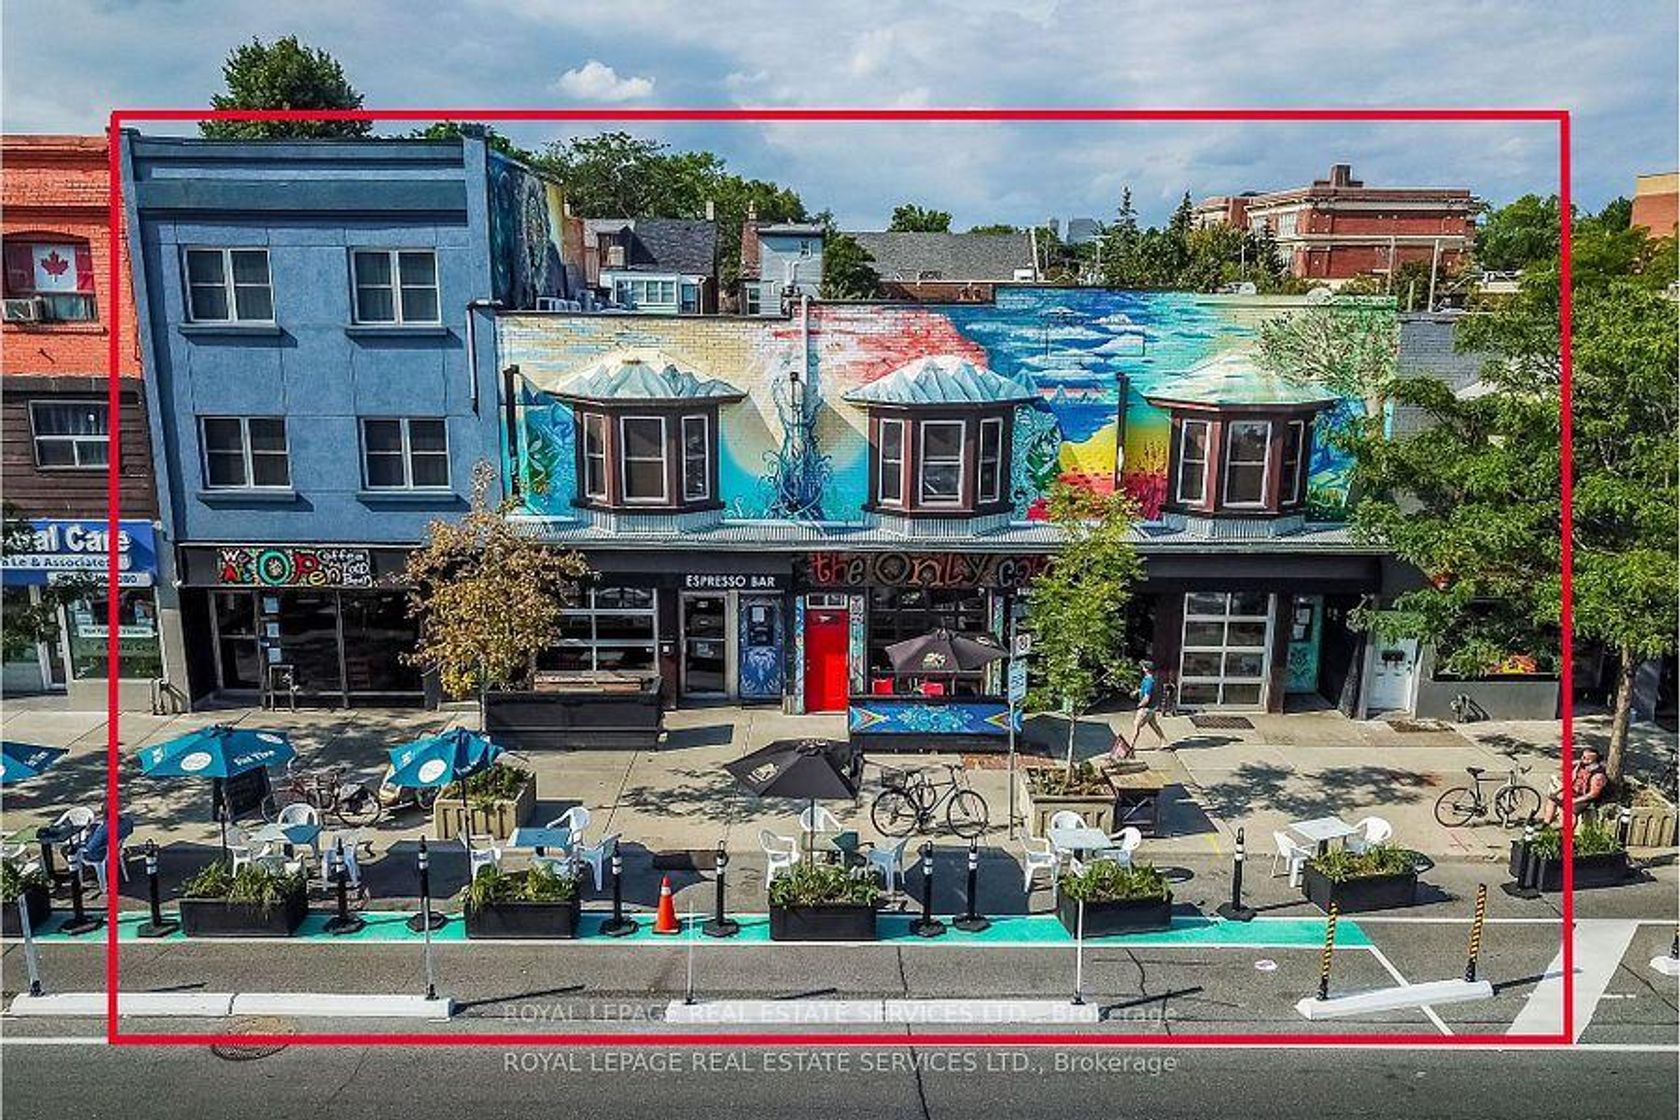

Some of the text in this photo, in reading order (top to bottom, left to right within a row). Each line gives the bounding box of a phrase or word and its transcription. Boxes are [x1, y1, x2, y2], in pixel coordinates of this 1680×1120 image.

[31, 556, 40, 567] &
[812, 551, 864, 585] the
[686, 575, 776, 588] ESPRESSO BAR
